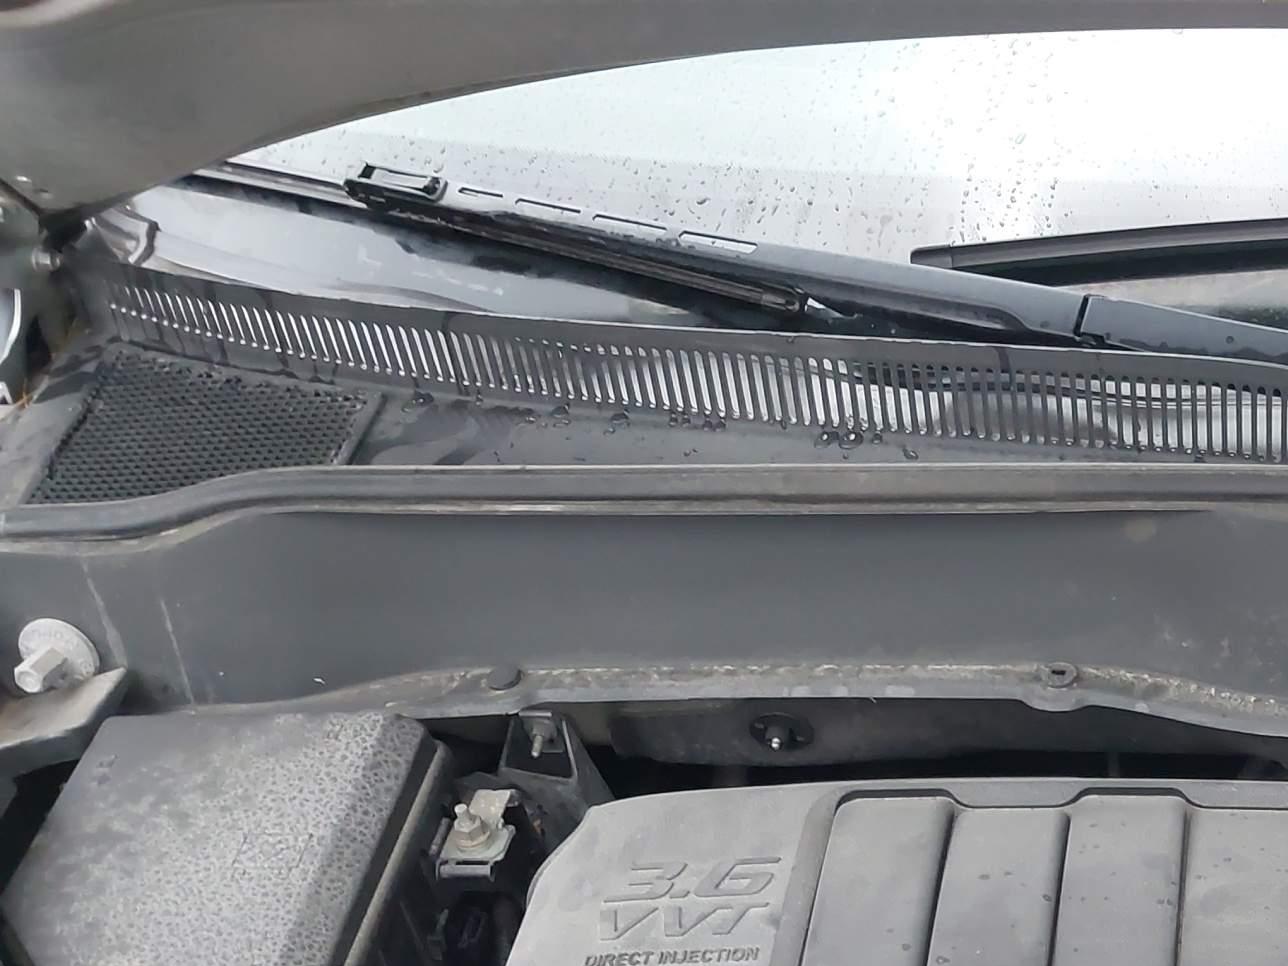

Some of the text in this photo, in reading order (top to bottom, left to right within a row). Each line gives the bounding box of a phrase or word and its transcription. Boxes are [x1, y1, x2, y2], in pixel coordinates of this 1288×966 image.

[603, 857, 782, 903] 3.6
[599, 902, 770, 941] VVT
[657, 947, 761, 966] INJECTION
